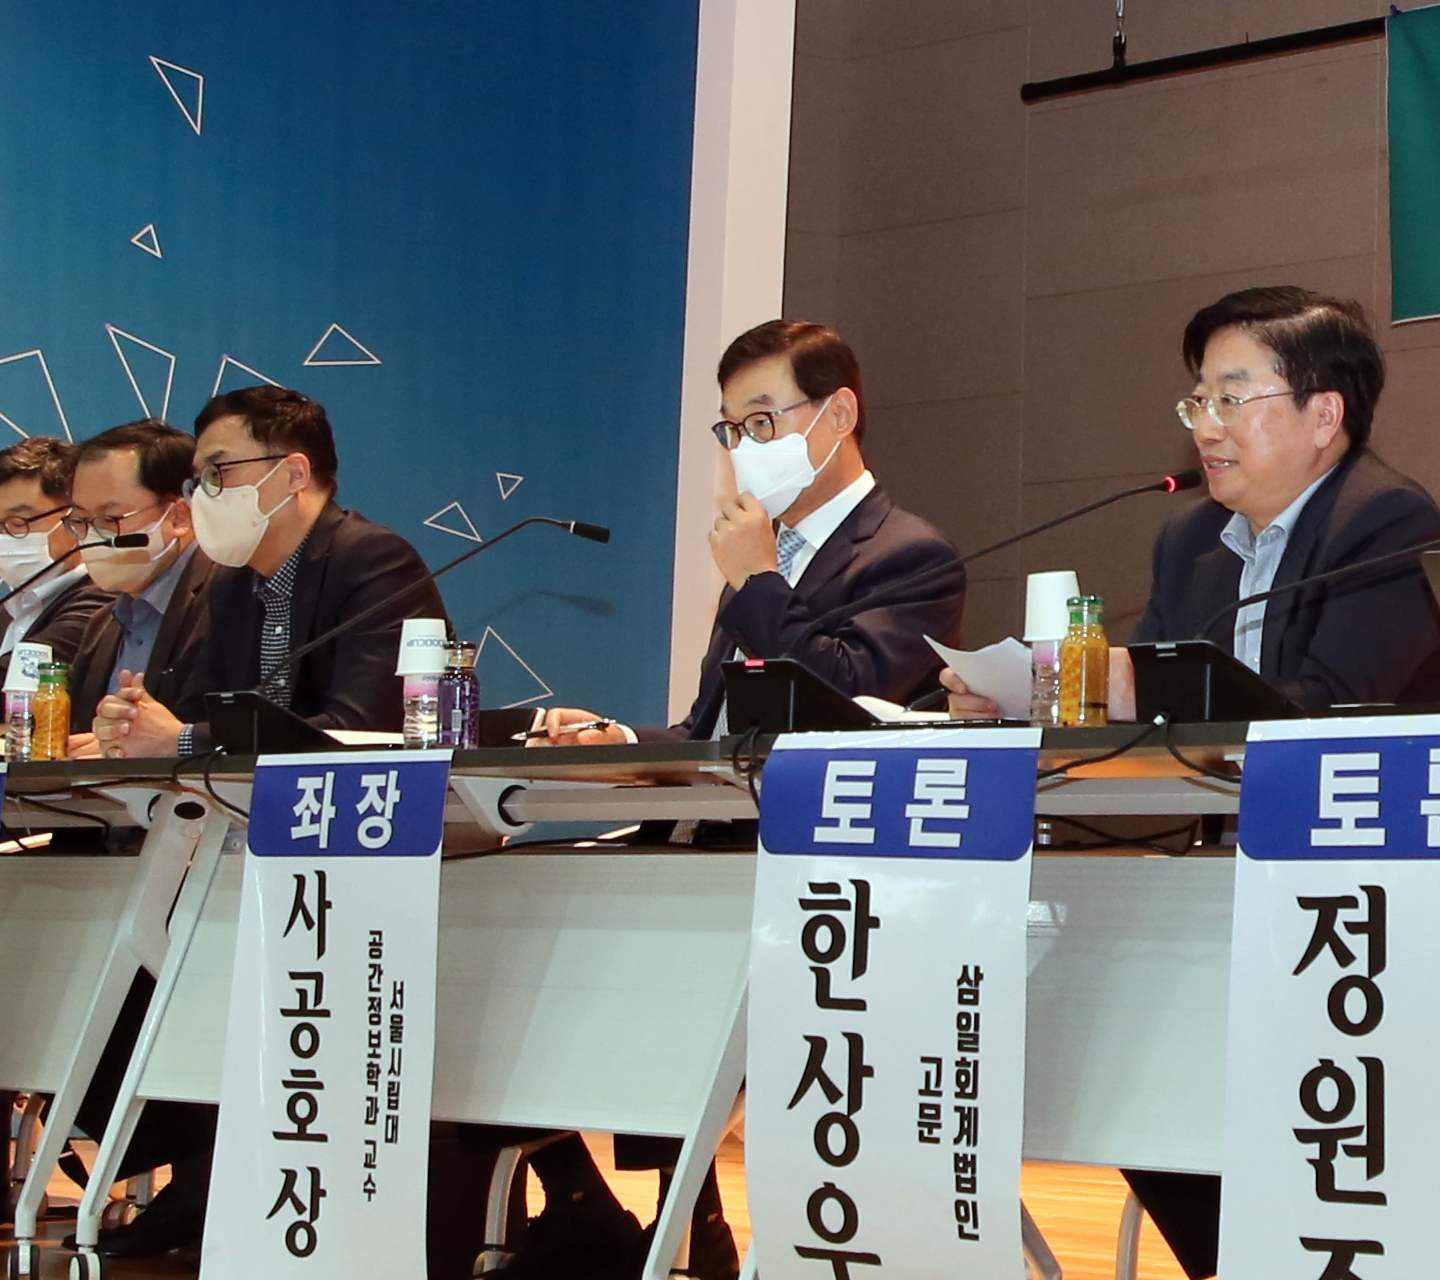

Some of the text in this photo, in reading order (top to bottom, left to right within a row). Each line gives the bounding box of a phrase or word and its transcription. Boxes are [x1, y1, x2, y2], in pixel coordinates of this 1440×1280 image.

[267, 870, 332, 1257] 사공호상
[363, 931, 383, 1201] 공간정보학과 교수
[385, 981, 404, 1144] 서울시립대
[917, 1056, 942, 1144] 고문
[953, 965, 983, 1241] 삼일회계법인
